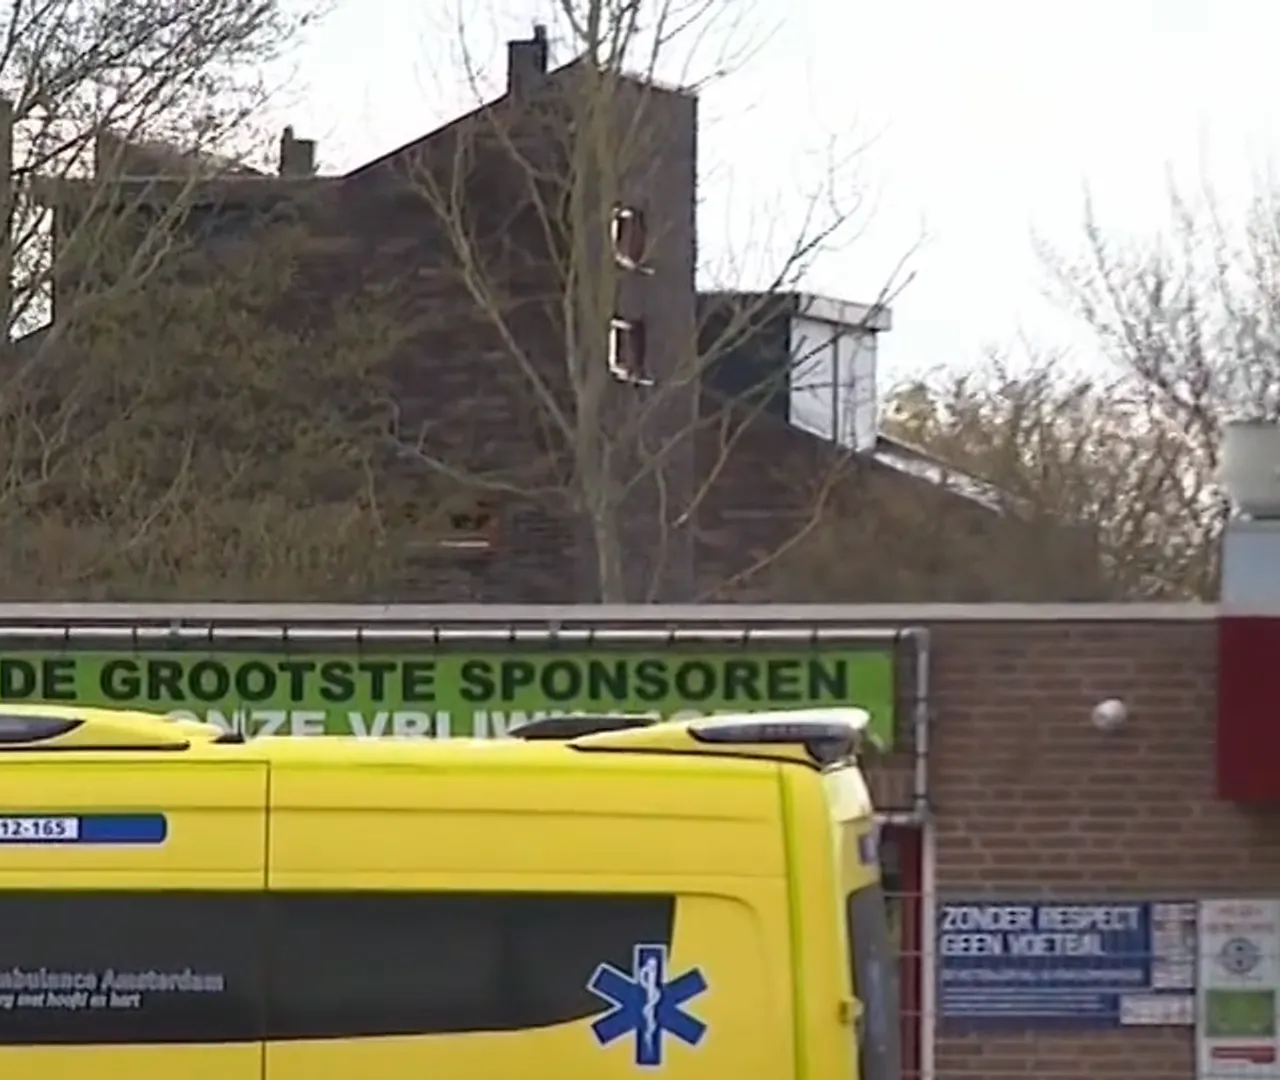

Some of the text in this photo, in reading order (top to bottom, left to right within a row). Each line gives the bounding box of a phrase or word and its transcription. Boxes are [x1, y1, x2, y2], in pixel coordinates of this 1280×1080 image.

[0, 658, 848, 702] DE GROOTSTE SPONSOREN
[1, 821, 66, 836] 12-165
[942, 905, 1032, 930] ZONDER
